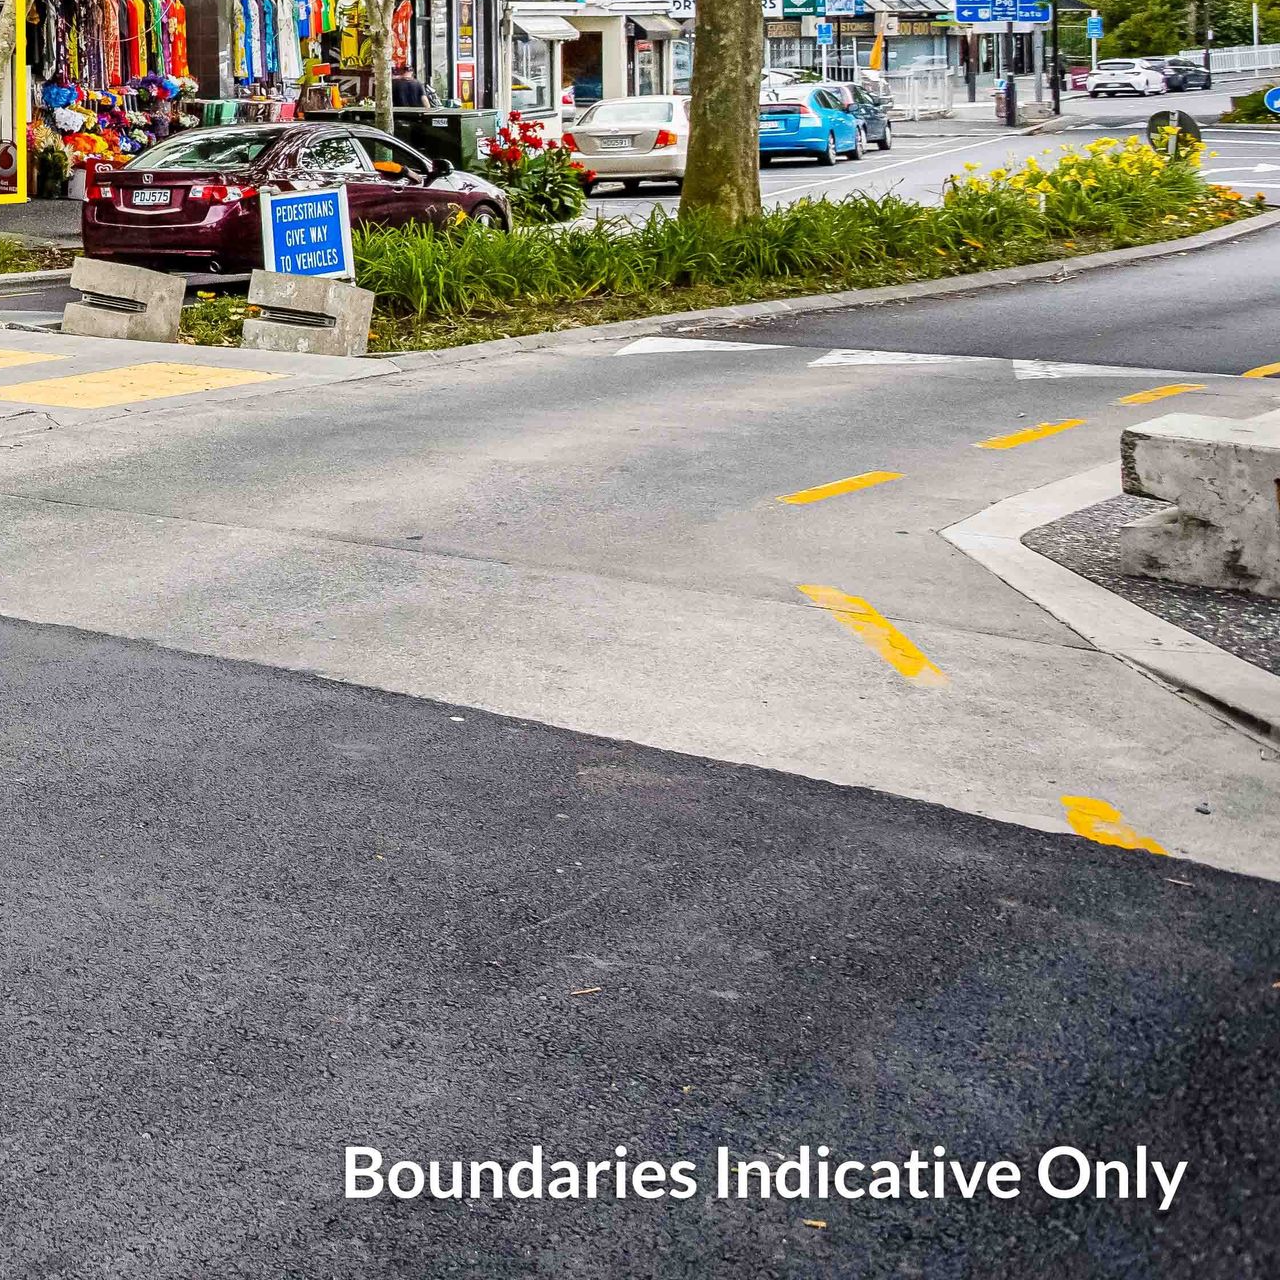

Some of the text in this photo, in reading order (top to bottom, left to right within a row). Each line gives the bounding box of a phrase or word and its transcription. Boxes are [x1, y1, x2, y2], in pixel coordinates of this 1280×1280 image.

[133, 190, 169, 203] PDJ575
[276, 199, 335, 223] PEDESTRIANS
[285, 225, 328, 248] GIVE WAY
[280, 248, 339, 273] TO VEHICLES
